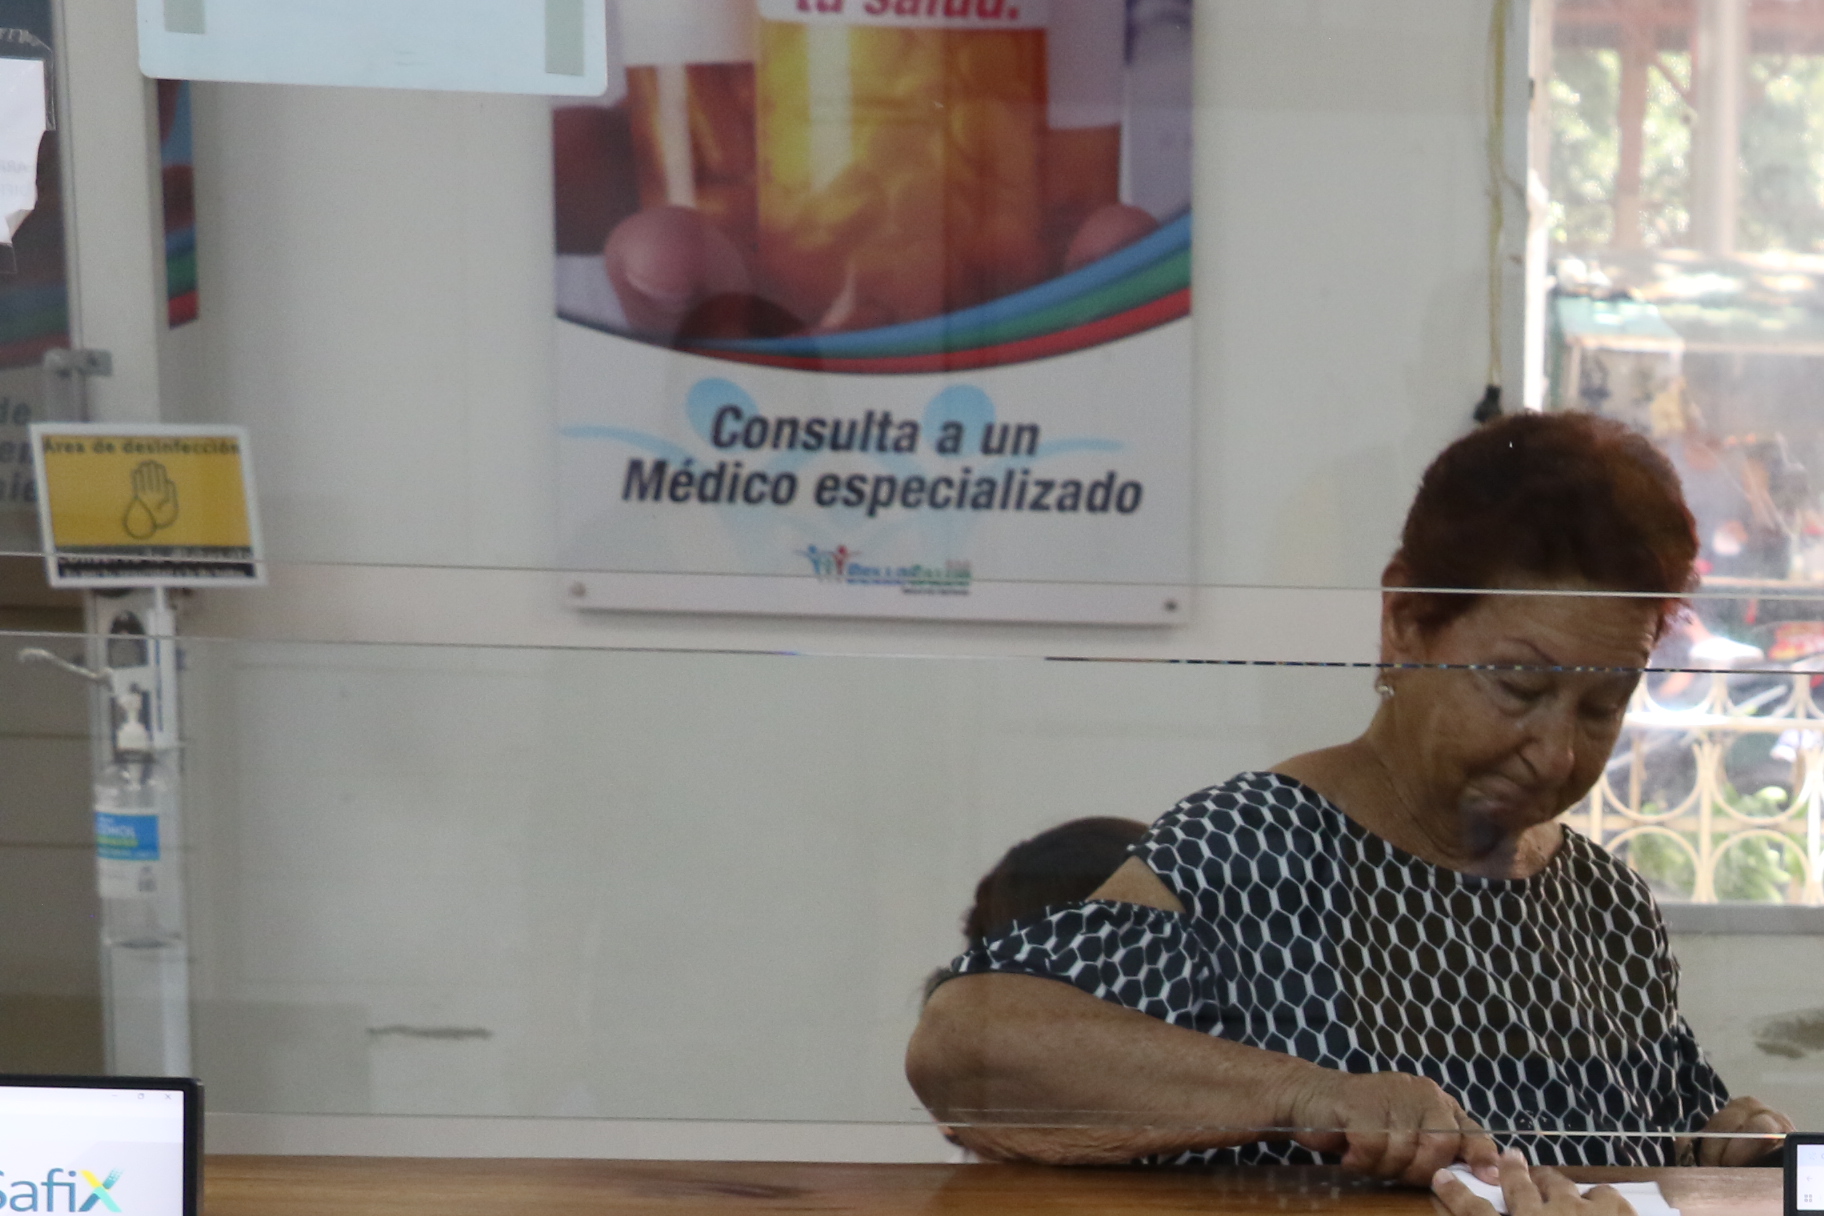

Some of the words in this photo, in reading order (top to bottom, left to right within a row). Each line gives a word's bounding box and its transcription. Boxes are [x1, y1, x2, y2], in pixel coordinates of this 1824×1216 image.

[710, 404, 920, 454] Consulta
[935, 419, 965, 456] a
[979, 421, 1040, 458] un
[620, 456, 799, 507] Médico
[813, 466, 1144, 519] especializado
